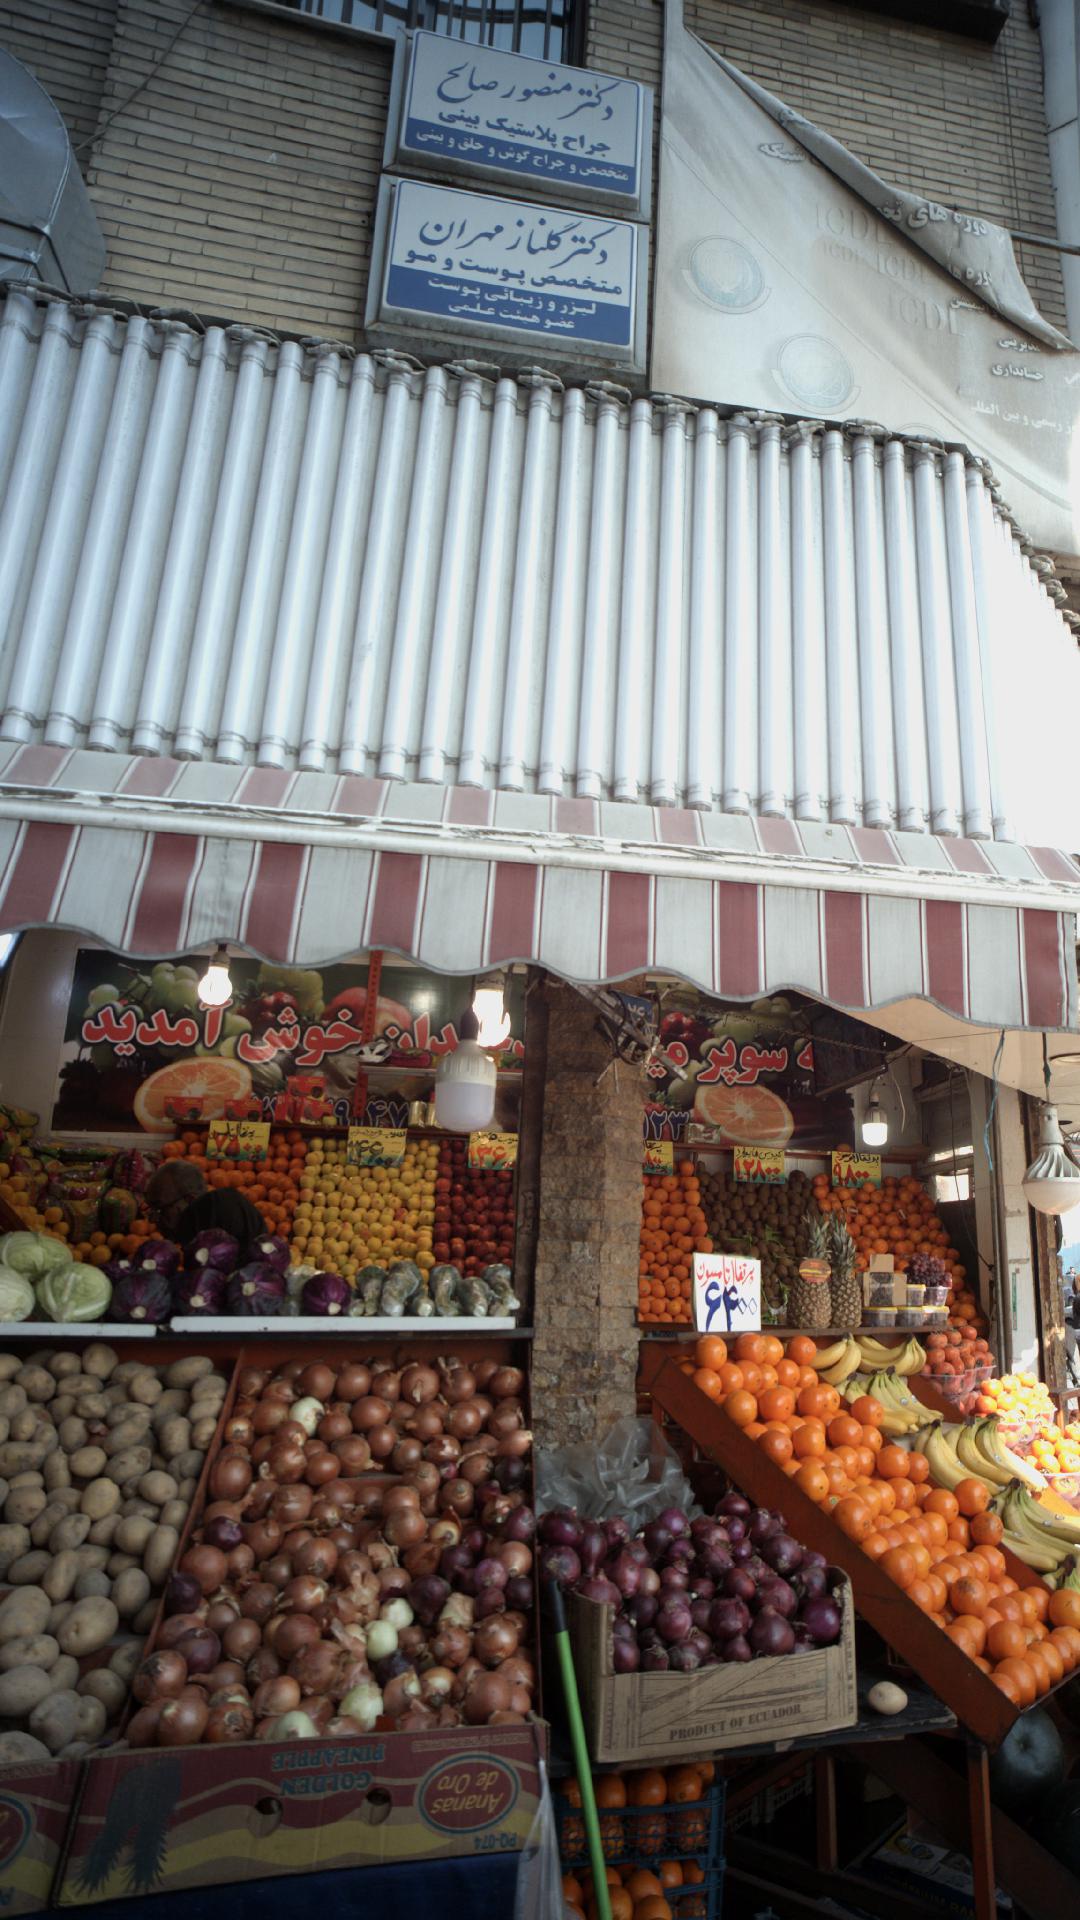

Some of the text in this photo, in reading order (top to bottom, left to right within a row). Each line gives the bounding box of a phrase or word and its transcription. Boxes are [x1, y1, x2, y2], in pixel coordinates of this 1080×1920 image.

[437, 61, 621, 121] دکتر منصور صالح
[439, 109, 611, 158] جراح پلاستیک بینی
[416, 128, 629, 181] متخصص و جراح گوش و حلق و بینی
[907, 203, 947, 229] های
[951, 211, 988, 237] دوره
[420, 217, 616, 269] دکتر گلناز مهران
[404, 248, 622, 295] متخصص پوست و مو
[427, 279, 597, 315] لیزر و زیبائی پوست
[448, 302, 495, 317] علمی
[544, 316, 576, 329] عضو
[991, 363, 1044, 381] حسابداری
[82, 998, 233, 1056] آمدید
[238, 1006, 362, 1066] خوش
[697, 1039, 788, 1085] سوپر
[731, 1256, 755, 1286] پرتقال
[669, 1703, 802, 1741] PRODUCT OF ECUADOR
[272, 1743, 385, 1771] PINEAPPLE
[280, 1771, 374, 1796] GOLDEN
[436, 1770, 499, 1795] de Oro
[430, 1792, 504, 1814] Ananas
